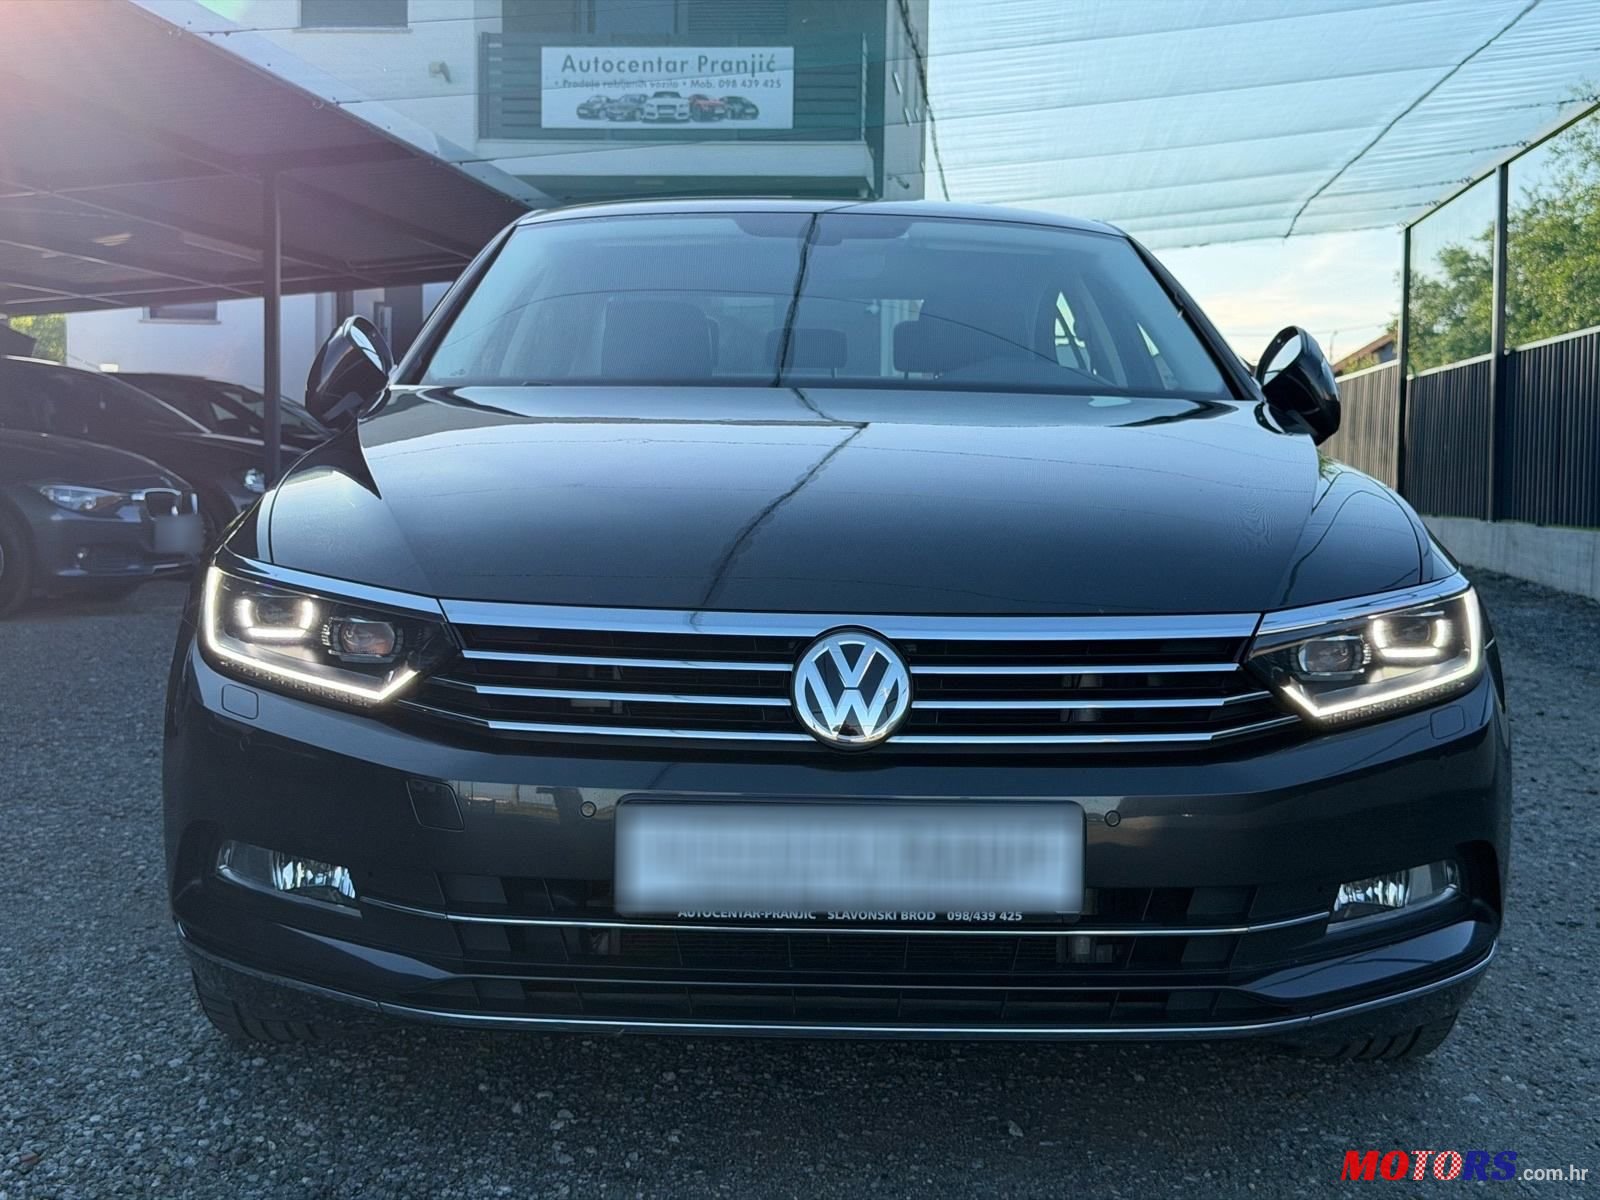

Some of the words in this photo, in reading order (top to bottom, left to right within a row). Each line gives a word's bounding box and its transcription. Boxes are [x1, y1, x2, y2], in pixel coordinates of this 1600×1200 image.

[561, 54, 689, 74] Autocentar
[698, 53, 776, 77] Pranjić
[690, 79, 715, 89] Mob.
[718, 79, 738, 89] 098
[741, 79, 760, 89] 439
[763, 79, 782, 89] 425
[827, 911, 897, 921] SLAVONSKI
[900, 911, 937, 922] BROD
[947, 911, 996, 922] 098/439
[999, 911, 1023, 922] 425
